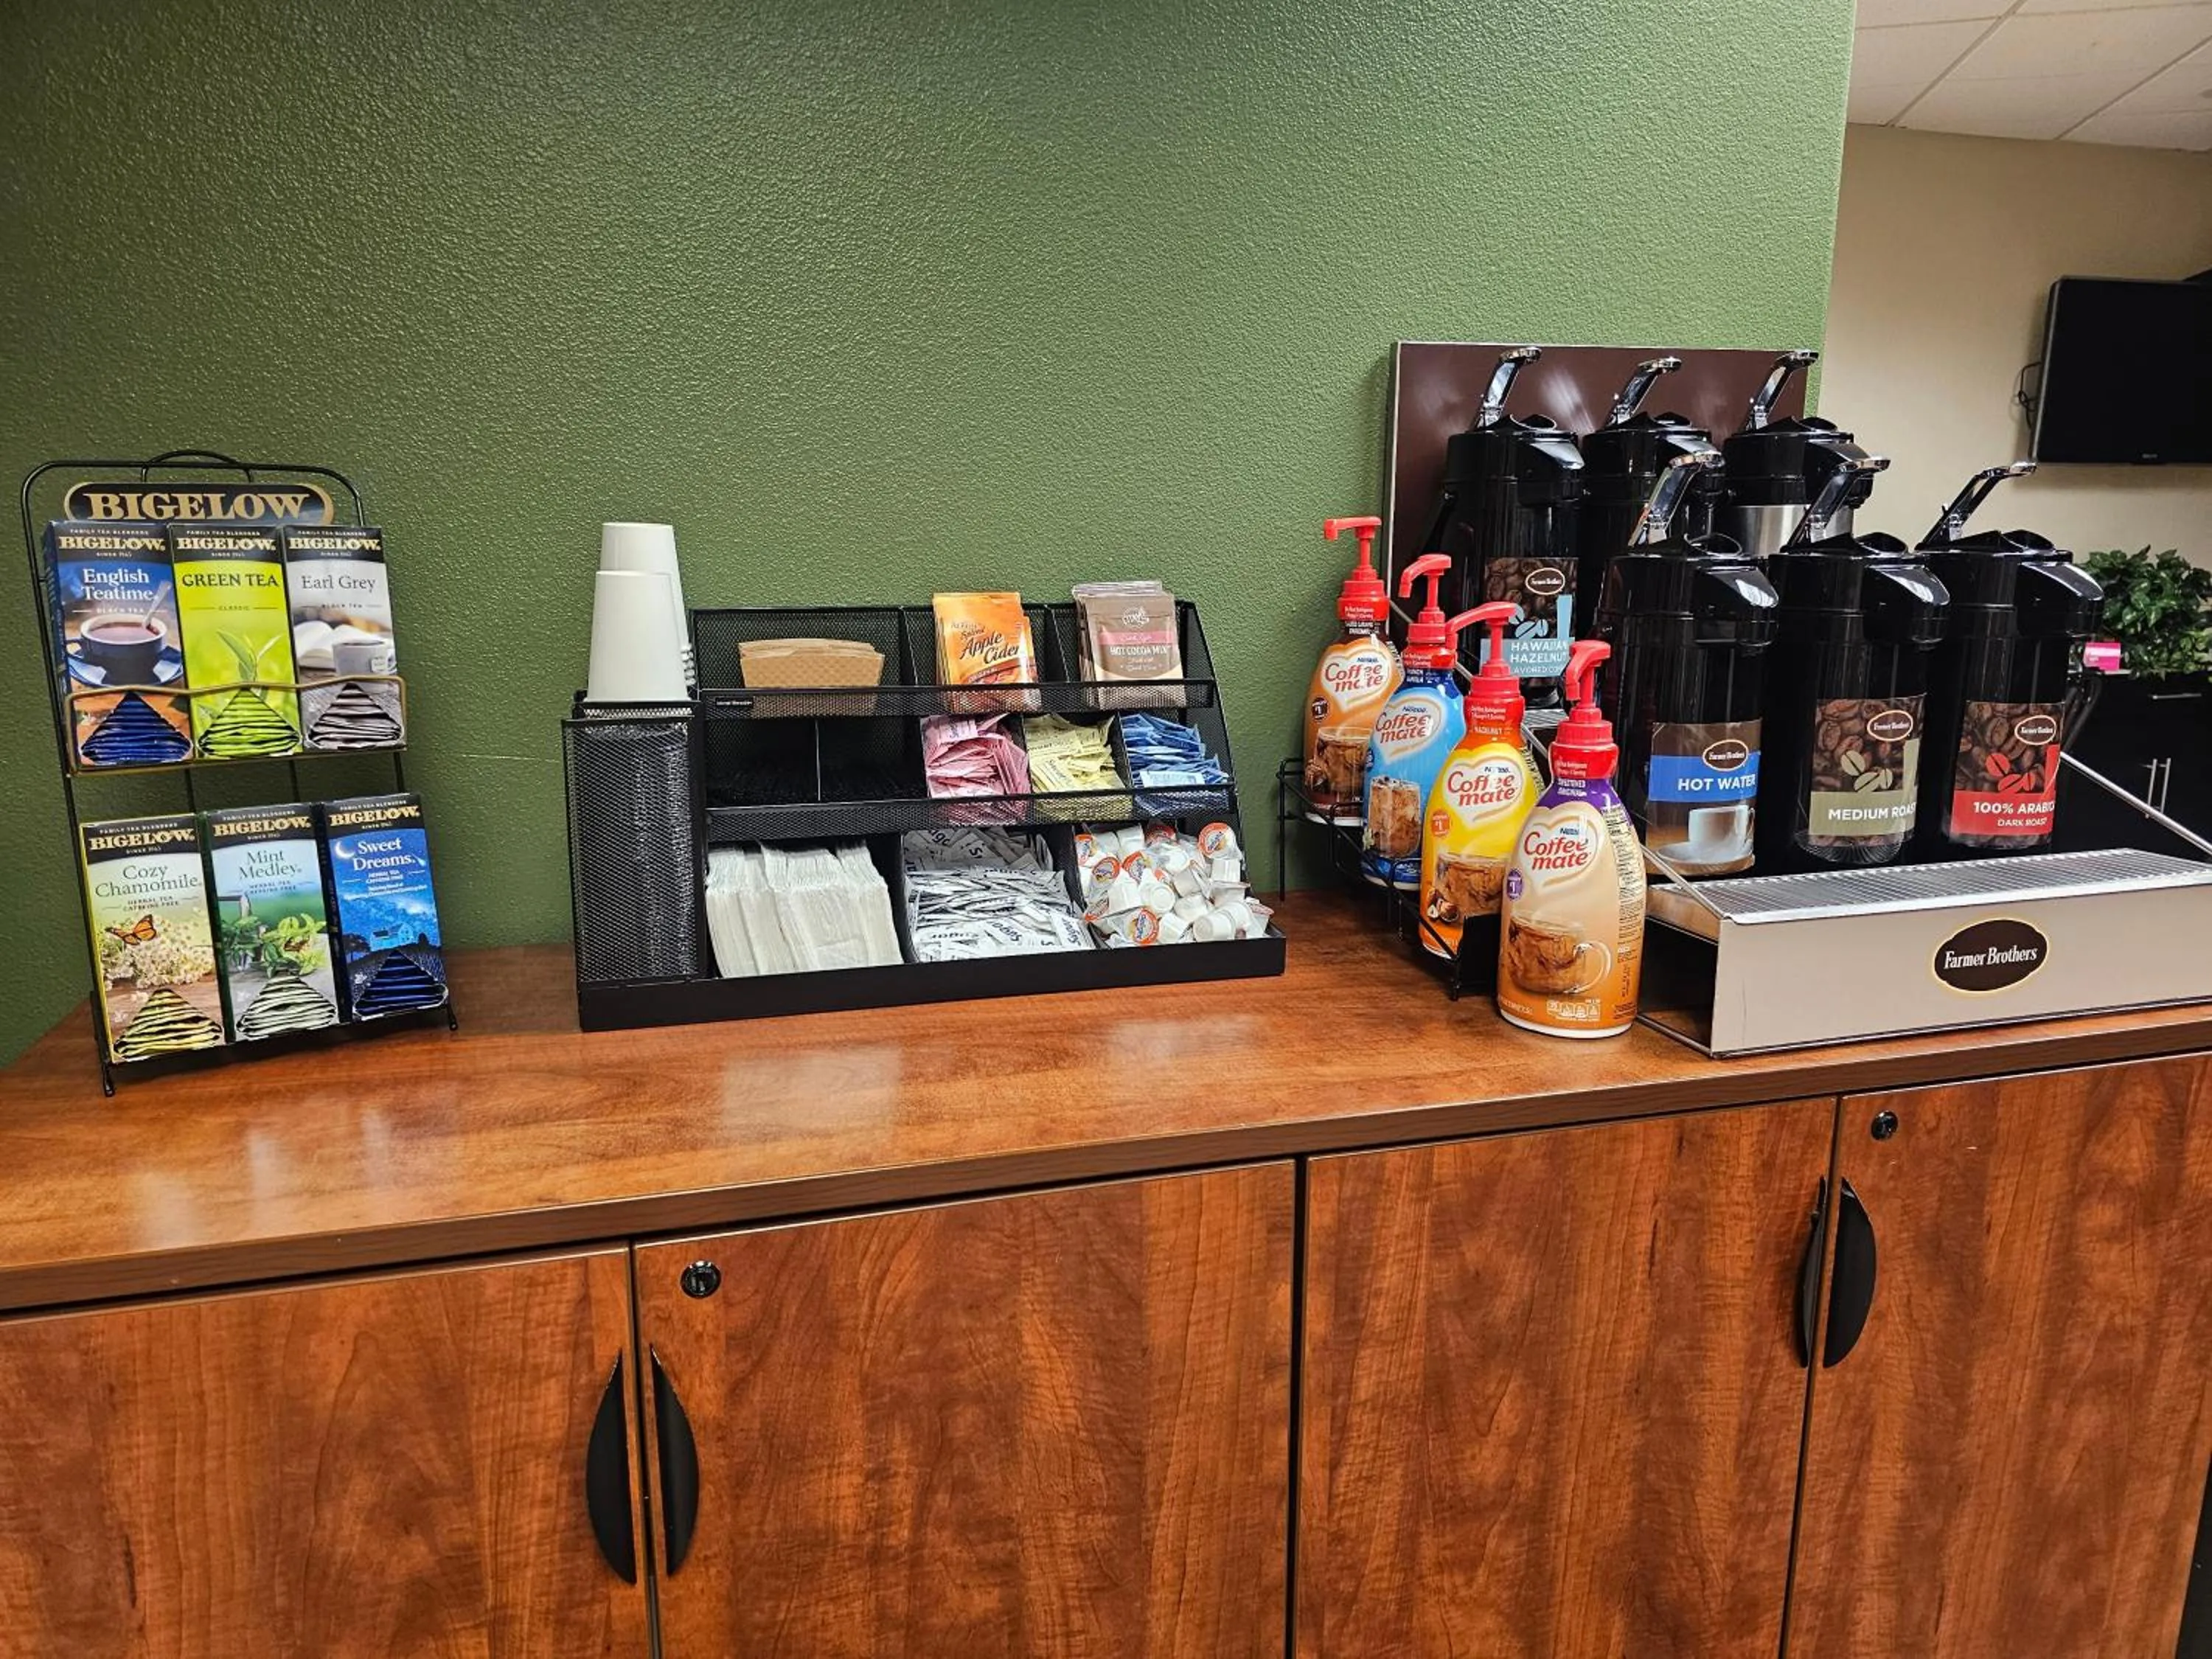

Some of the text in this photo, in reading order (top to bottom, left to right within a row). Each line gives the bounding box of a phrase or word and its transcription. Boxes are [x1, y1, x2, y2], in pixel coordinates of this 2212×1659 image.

[83, 493, 310, 521] BIGELOW
[83, 568, 150, 588] English
[182, 574, 279, 588] GREEN TEA
[302, 575, 376, 593] Earl Grey
[81, 585, 153, 601] Teatime
[959, 630, 1004, 660] Apple
[983, 643, 1020, 664] Cider
[1110, 647, 1126, 655] HOT
[1127, 647, 1150, 655] COCOA
[1512, 641, 1568, 652] HAWAIIAN
[1511, 653, 1568, 663] HAZELNUT
[1376, 712, 1430, 731] Coffee
[1380, 726, 1427, 743] mate
[1677, 773, 1756, 791] HOT WATER
[1458, 787, 1515, 806] mate
[1828, 808, 1888, 820] MEDIUM
[1973, 801, 2014, 814] 100%
[357, 837, 402, 855] Sweet
[1525, 831, 1589, 855] Coffee
[247, 849, 284, 865] Mint
[353, 854, 415, 871] Dreams
[1531, 850, 1589, 870] mate
[122, 864, 168, 881] Cozy
[239, 862, 299, 880] Medley
[95, 874, 198, 897] Chamomile
[1944, 945, 2038, 970] Farmer Brothers
